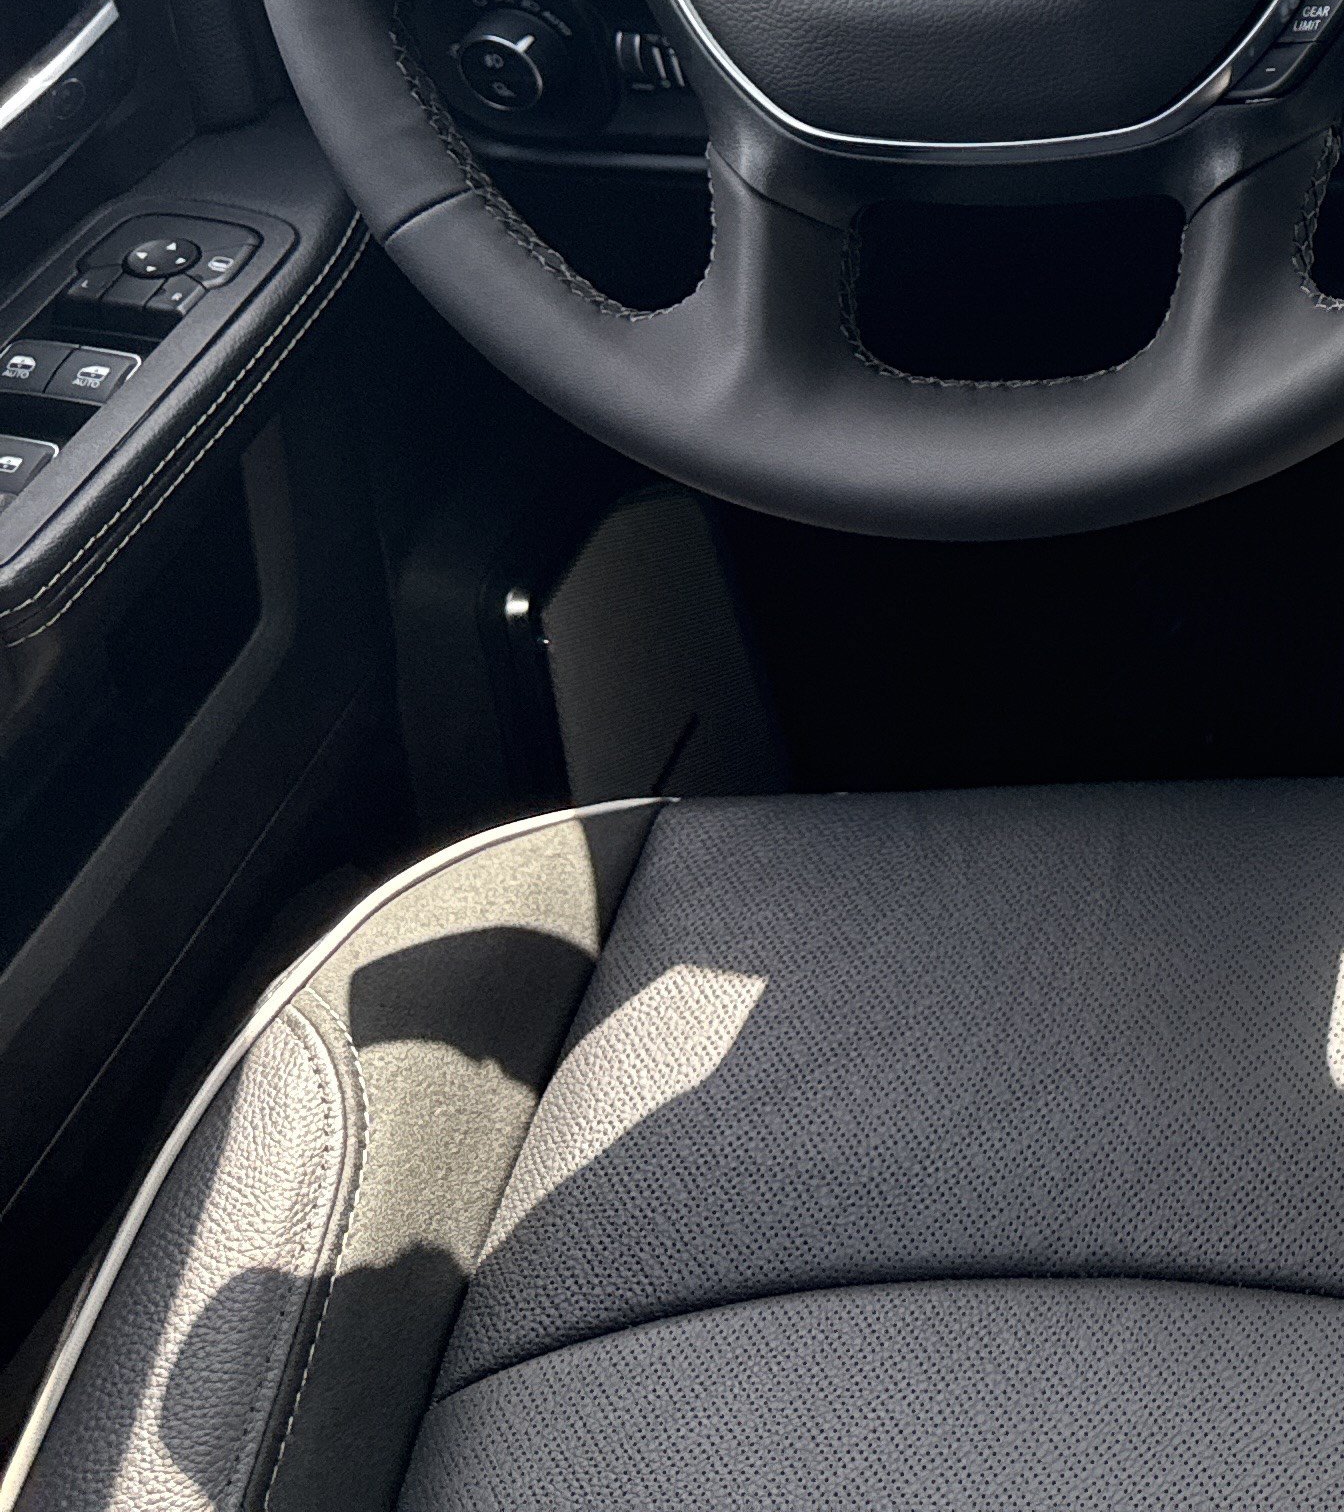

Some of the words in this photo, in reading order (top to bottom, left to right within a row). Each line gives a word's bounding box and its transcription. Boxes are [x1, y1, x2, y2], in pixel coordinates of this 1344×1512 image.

[1302, 4, 1331, 18] GEAR
[1293, 18, 1322, 33] LIMIT
[2, 368, 29, 380] AUTO
[72, 377, 100, 389] AUTO
